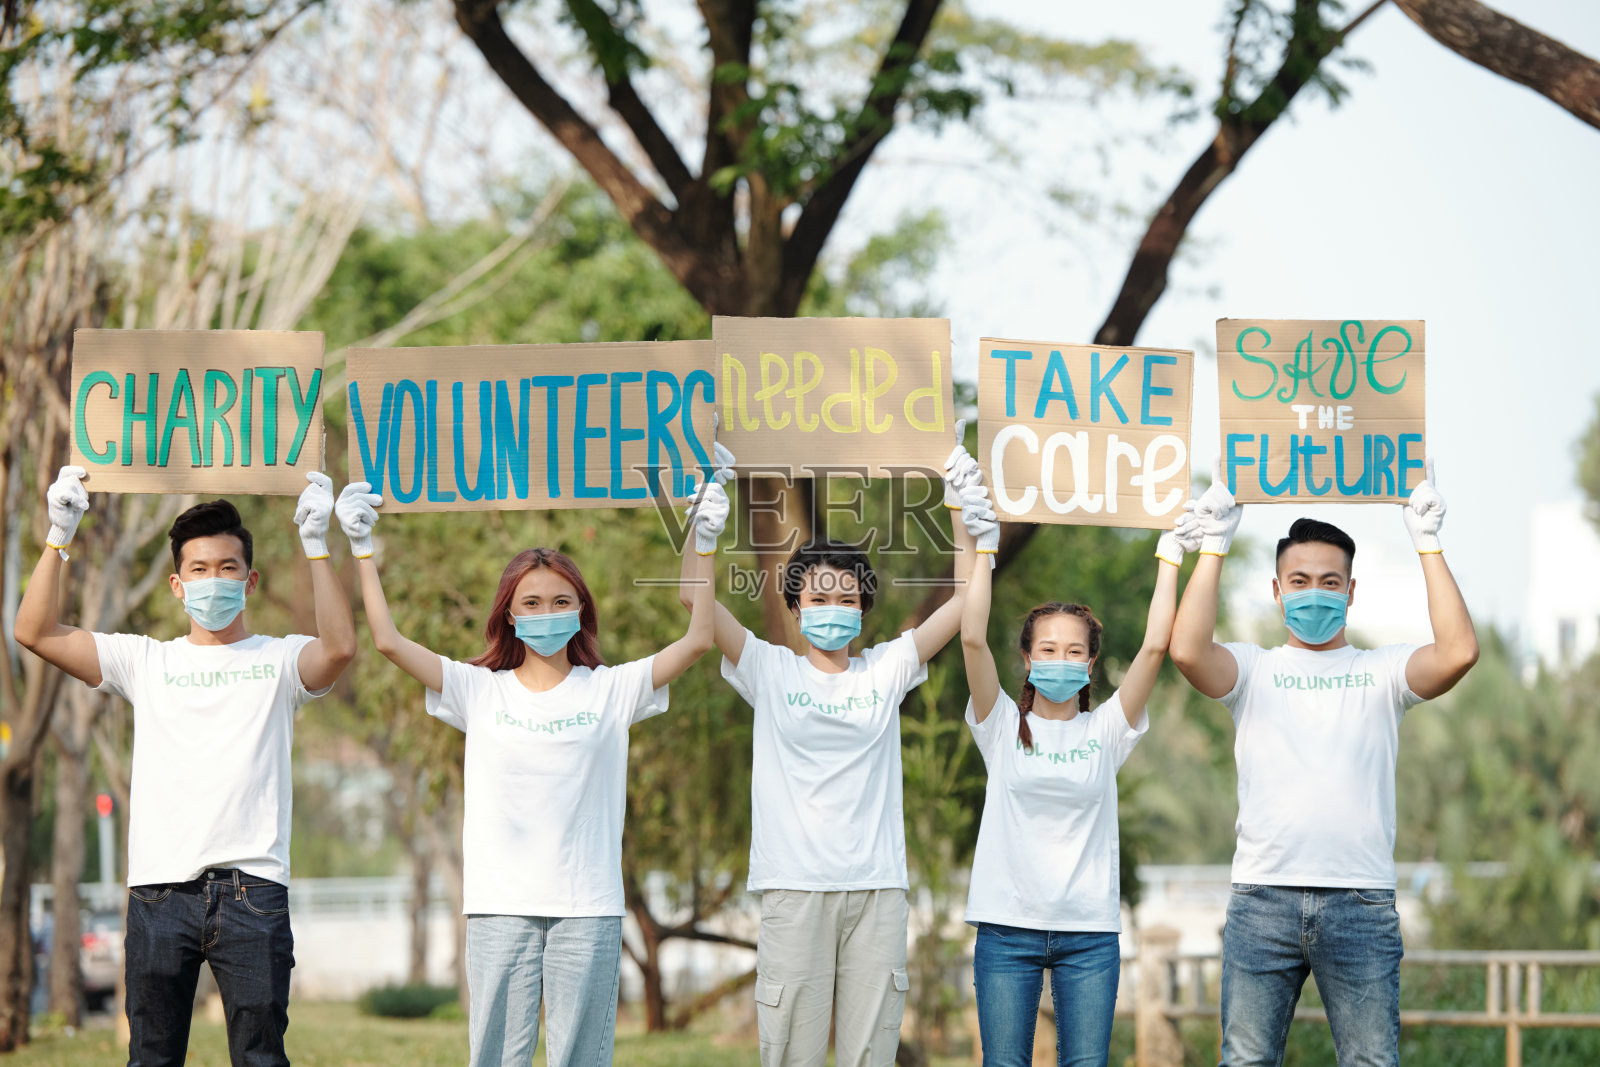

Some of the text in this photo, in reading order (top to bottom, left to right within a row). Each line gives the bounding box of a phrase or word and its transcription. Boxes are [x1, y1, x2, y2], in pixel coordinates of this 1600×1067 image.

[990, 349, 1178, 426] TAKE
[74, 367, 323, 468] CHARITY
[1291, 404, 1354, 430] THE
[348, 369, 715, 504] VOLUNTEERS
[164, 664, 276, 688] VOLUNTEER
[1273, 672, 1376, 691] VOLUNTEER
[787, 689, 884, 715] VOUNTEER
